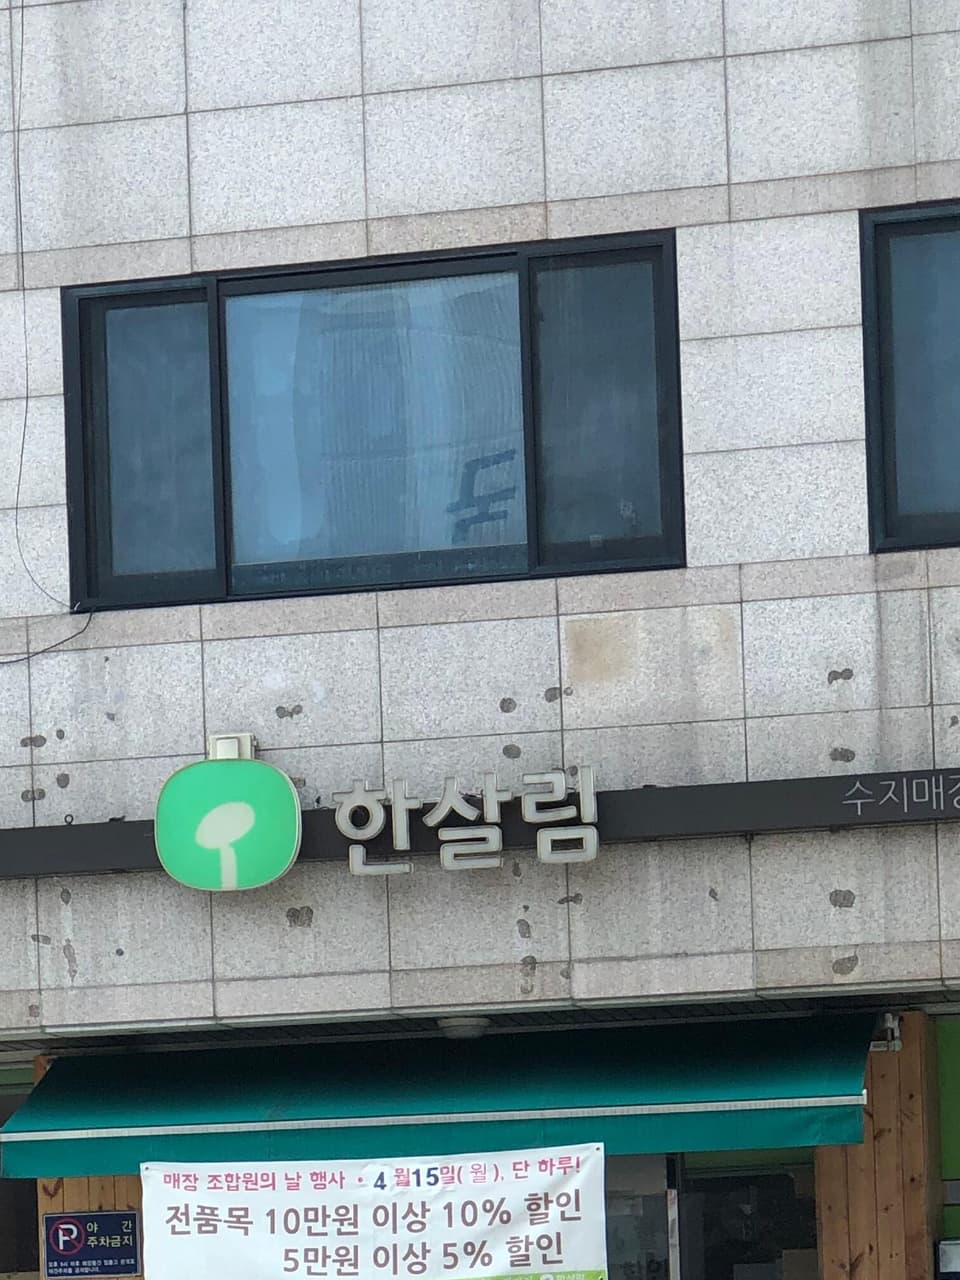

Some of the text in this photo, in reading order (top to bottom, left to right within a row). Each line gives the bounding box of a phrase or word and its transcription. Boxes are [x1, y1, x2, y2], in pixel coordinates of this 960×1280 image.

[332, 765, 599, 876] 한살림
[163, 1172, 199, 1192] 매장
[207, 1171, 276, 1192] 조합원의
[285, 1171, 302, 1191] 날
[310, 1170, 345, 1191] 행사
[512, 1160, 530, 1180] 단
[538, 1156, 581, 1176] 하루!
[166, 1188, 582, 1237] 전품목 10만원 이상 10% 할인
[87, 1235, 133, 1248] 주차금지
[283, 1231, 564, 1277] 5만원 이상 5% 할인
